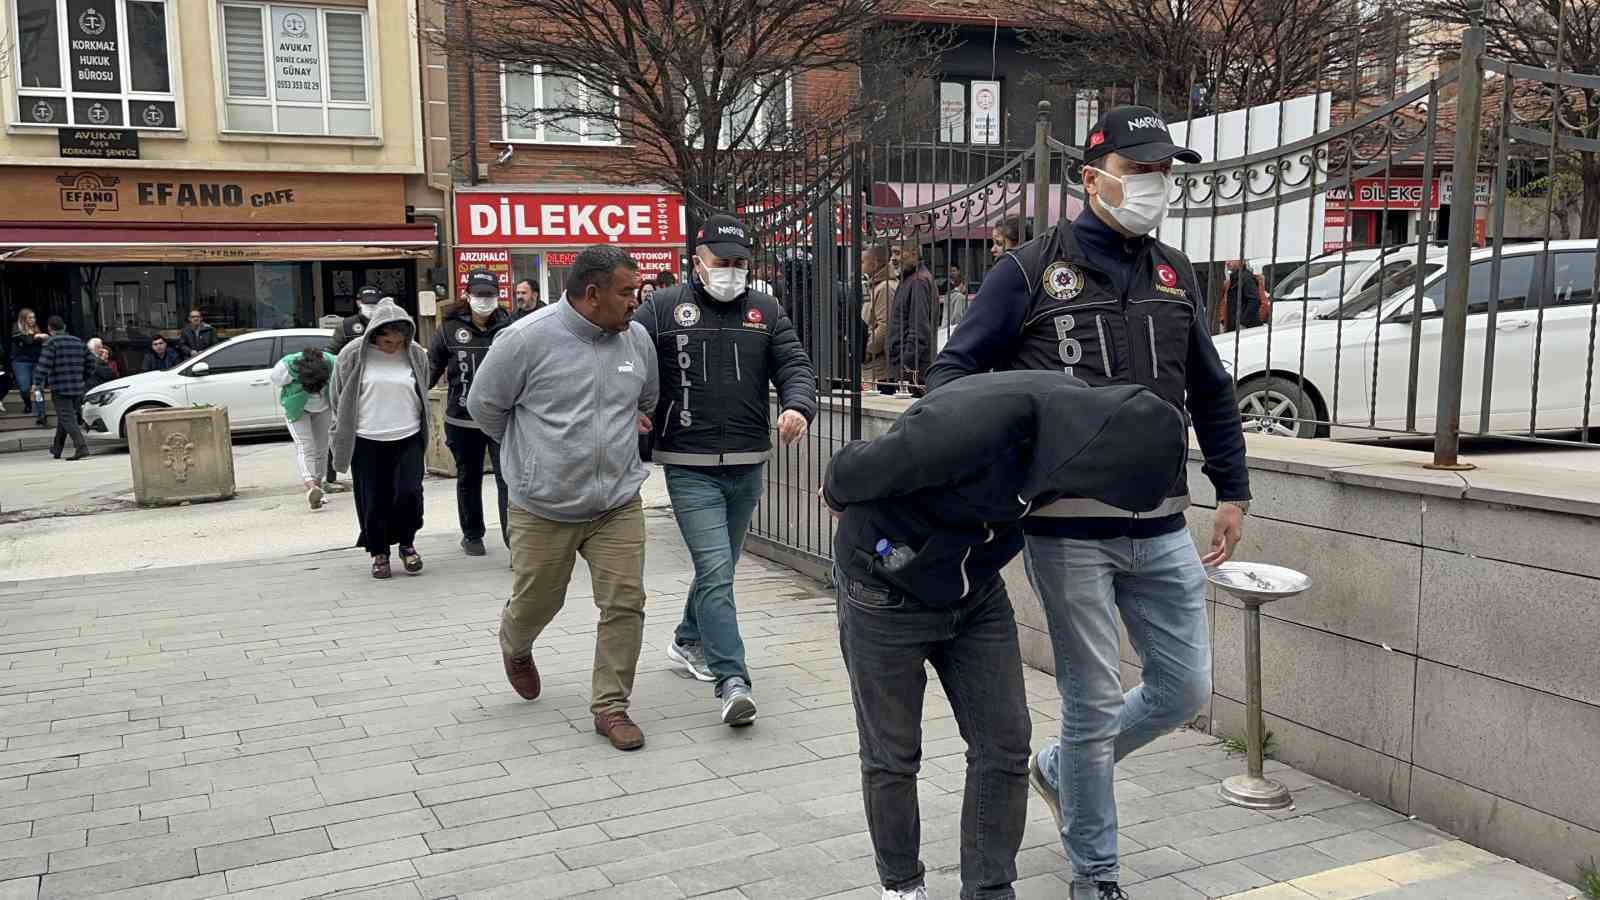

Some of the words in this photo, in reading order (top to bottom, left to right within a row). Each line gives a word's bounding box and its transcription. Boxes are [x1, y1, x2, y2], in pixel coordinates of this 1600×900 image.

[72, 40, 116, 51] KORKMAZ
[280, 42, 312, 52] AVUKAT
[80, 56, 110, 66] HUKUK
[78, 69, 113, 81] BÜROSU
[283, 65, 311, 76] GÜNAY
[74, 131, 122, 140] AVUKAT
[66, 191, 112, 202] EFANO
[137, 183, 243, 207] EFANO
[251, 189, 295, 207] CAFE
[470, 198, 652, 241] DİLEKÇE
[460, 251, 508, 262] ARZUHALCİ
